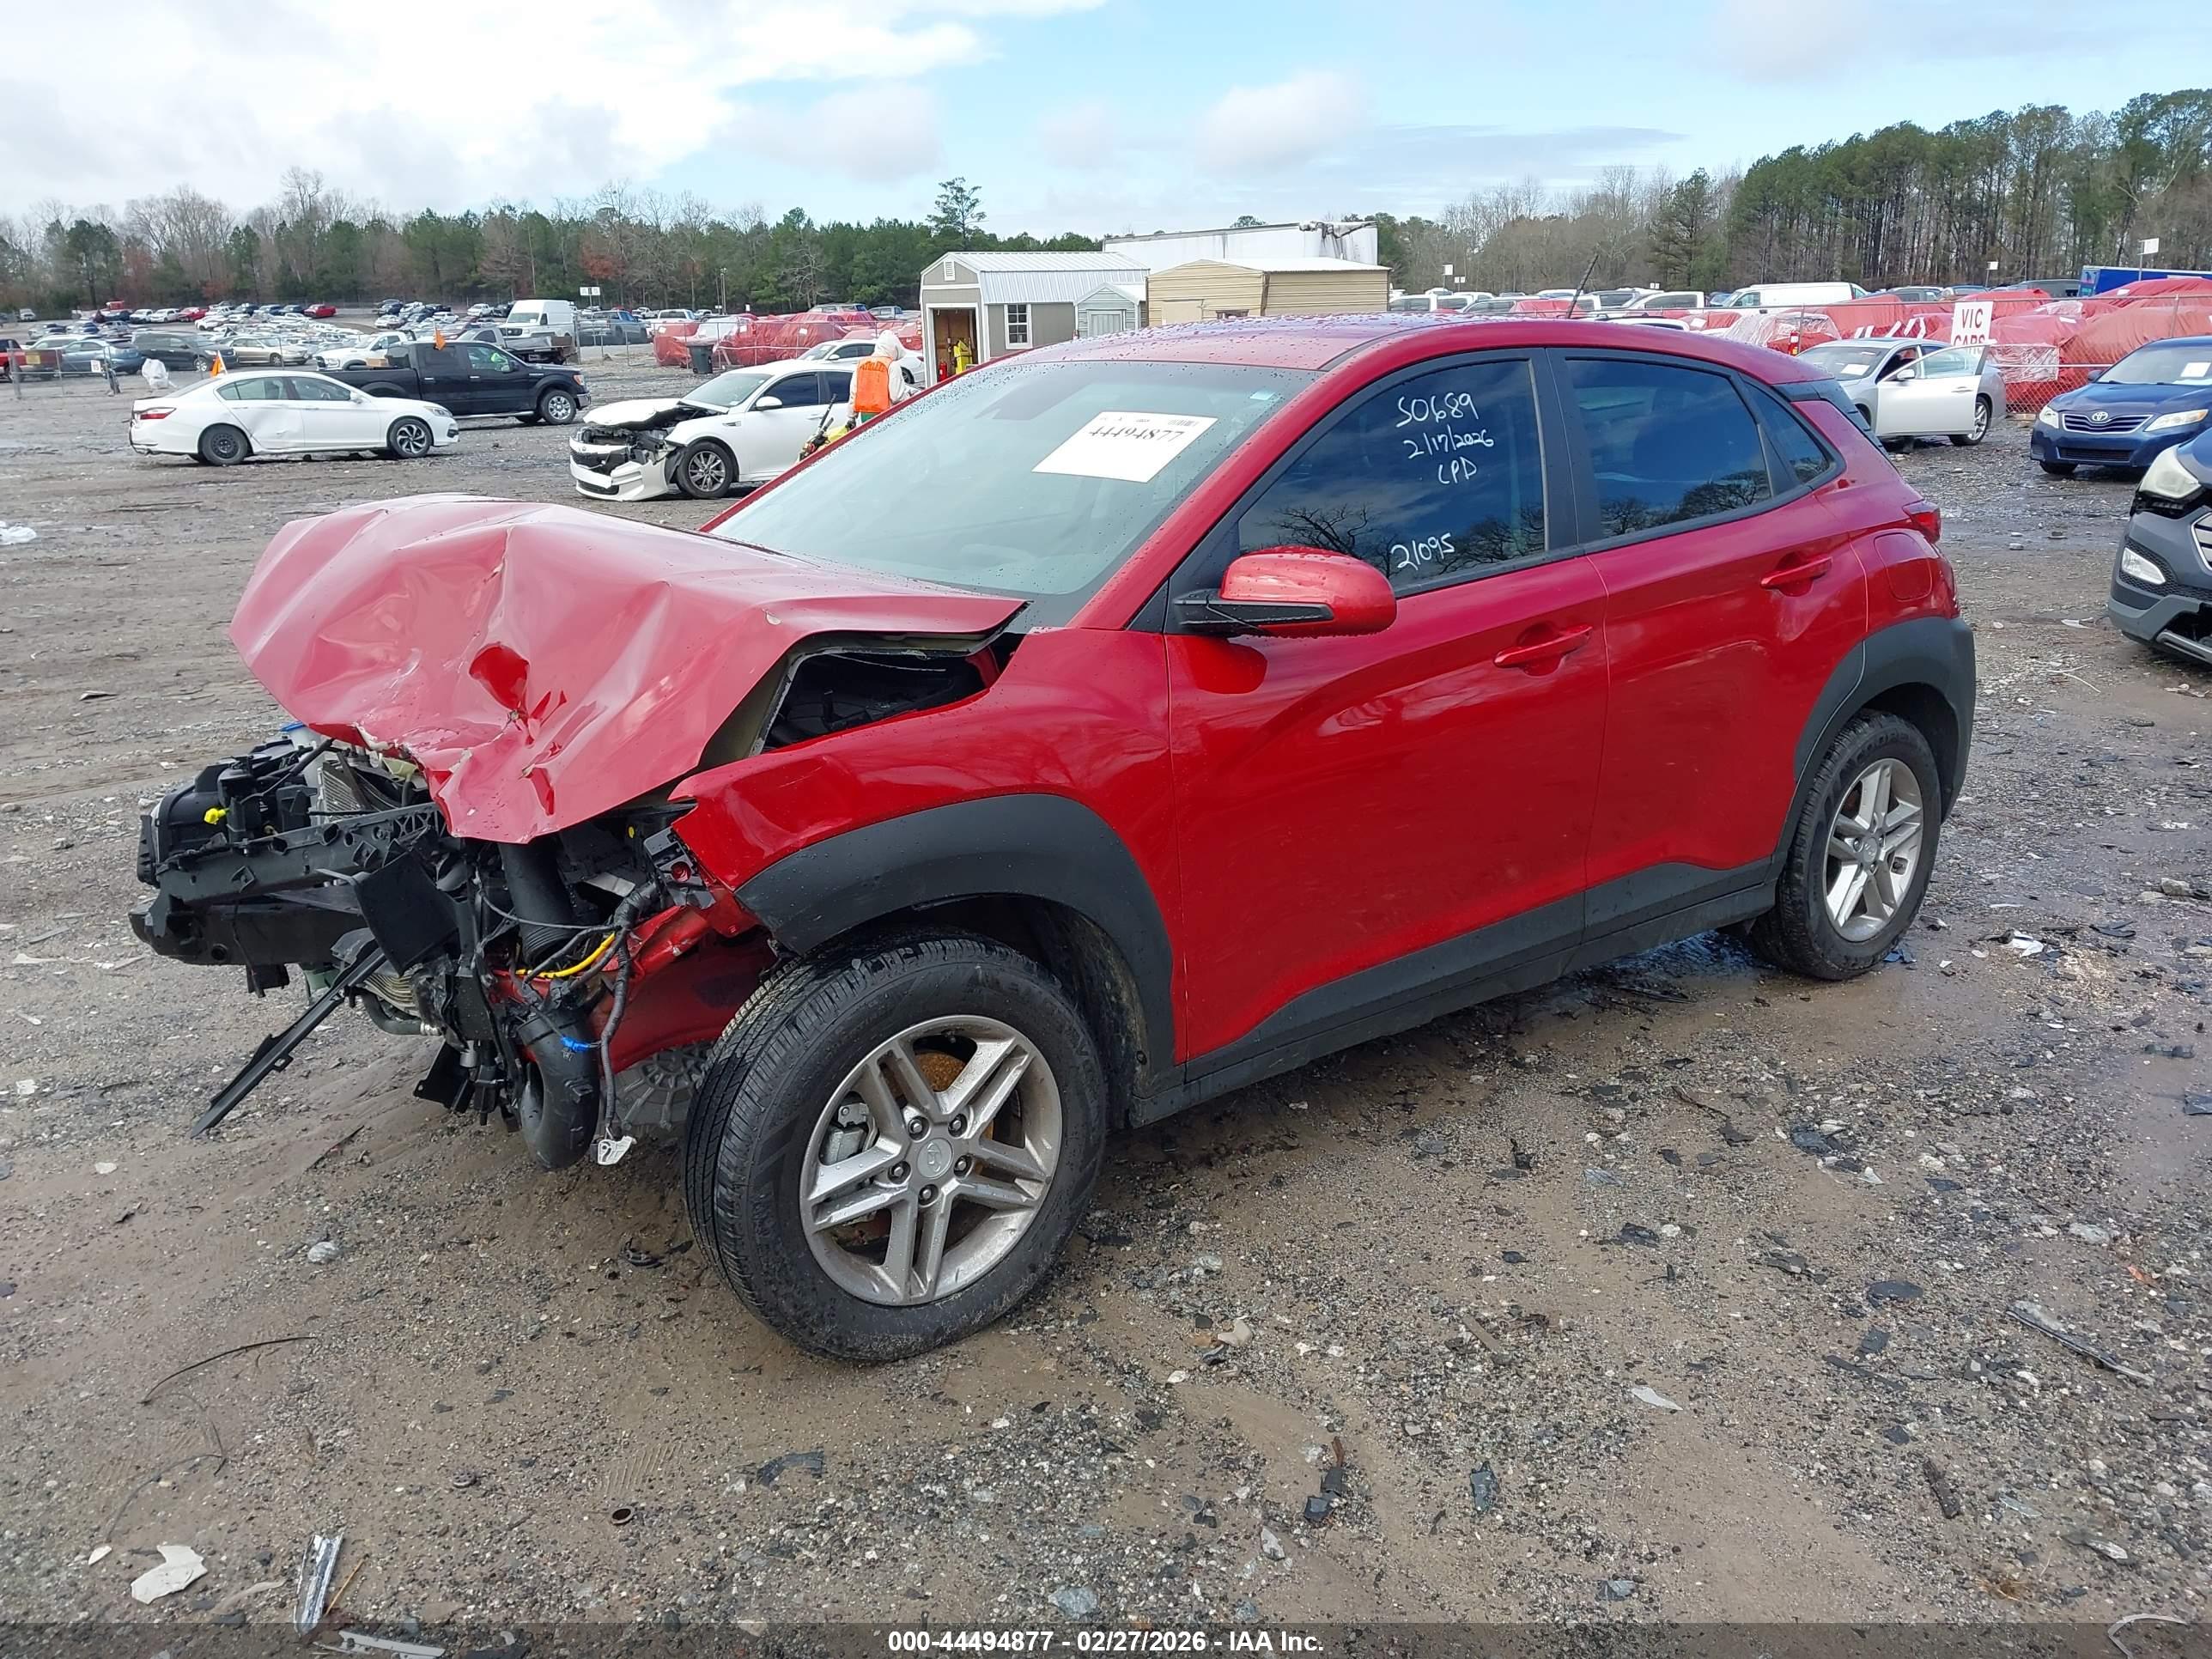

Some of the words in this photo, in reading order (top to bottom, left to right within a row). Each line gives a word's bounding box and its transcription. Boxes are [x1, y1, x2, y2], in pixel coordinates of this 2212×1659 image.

[1961, 308, 1984, 329] VIC
[1089, 426, 1185, 442] 44494877
[1402, 423, 1494, 459] 2/17/2026
[1390, 532, 1455, 571] 21095
